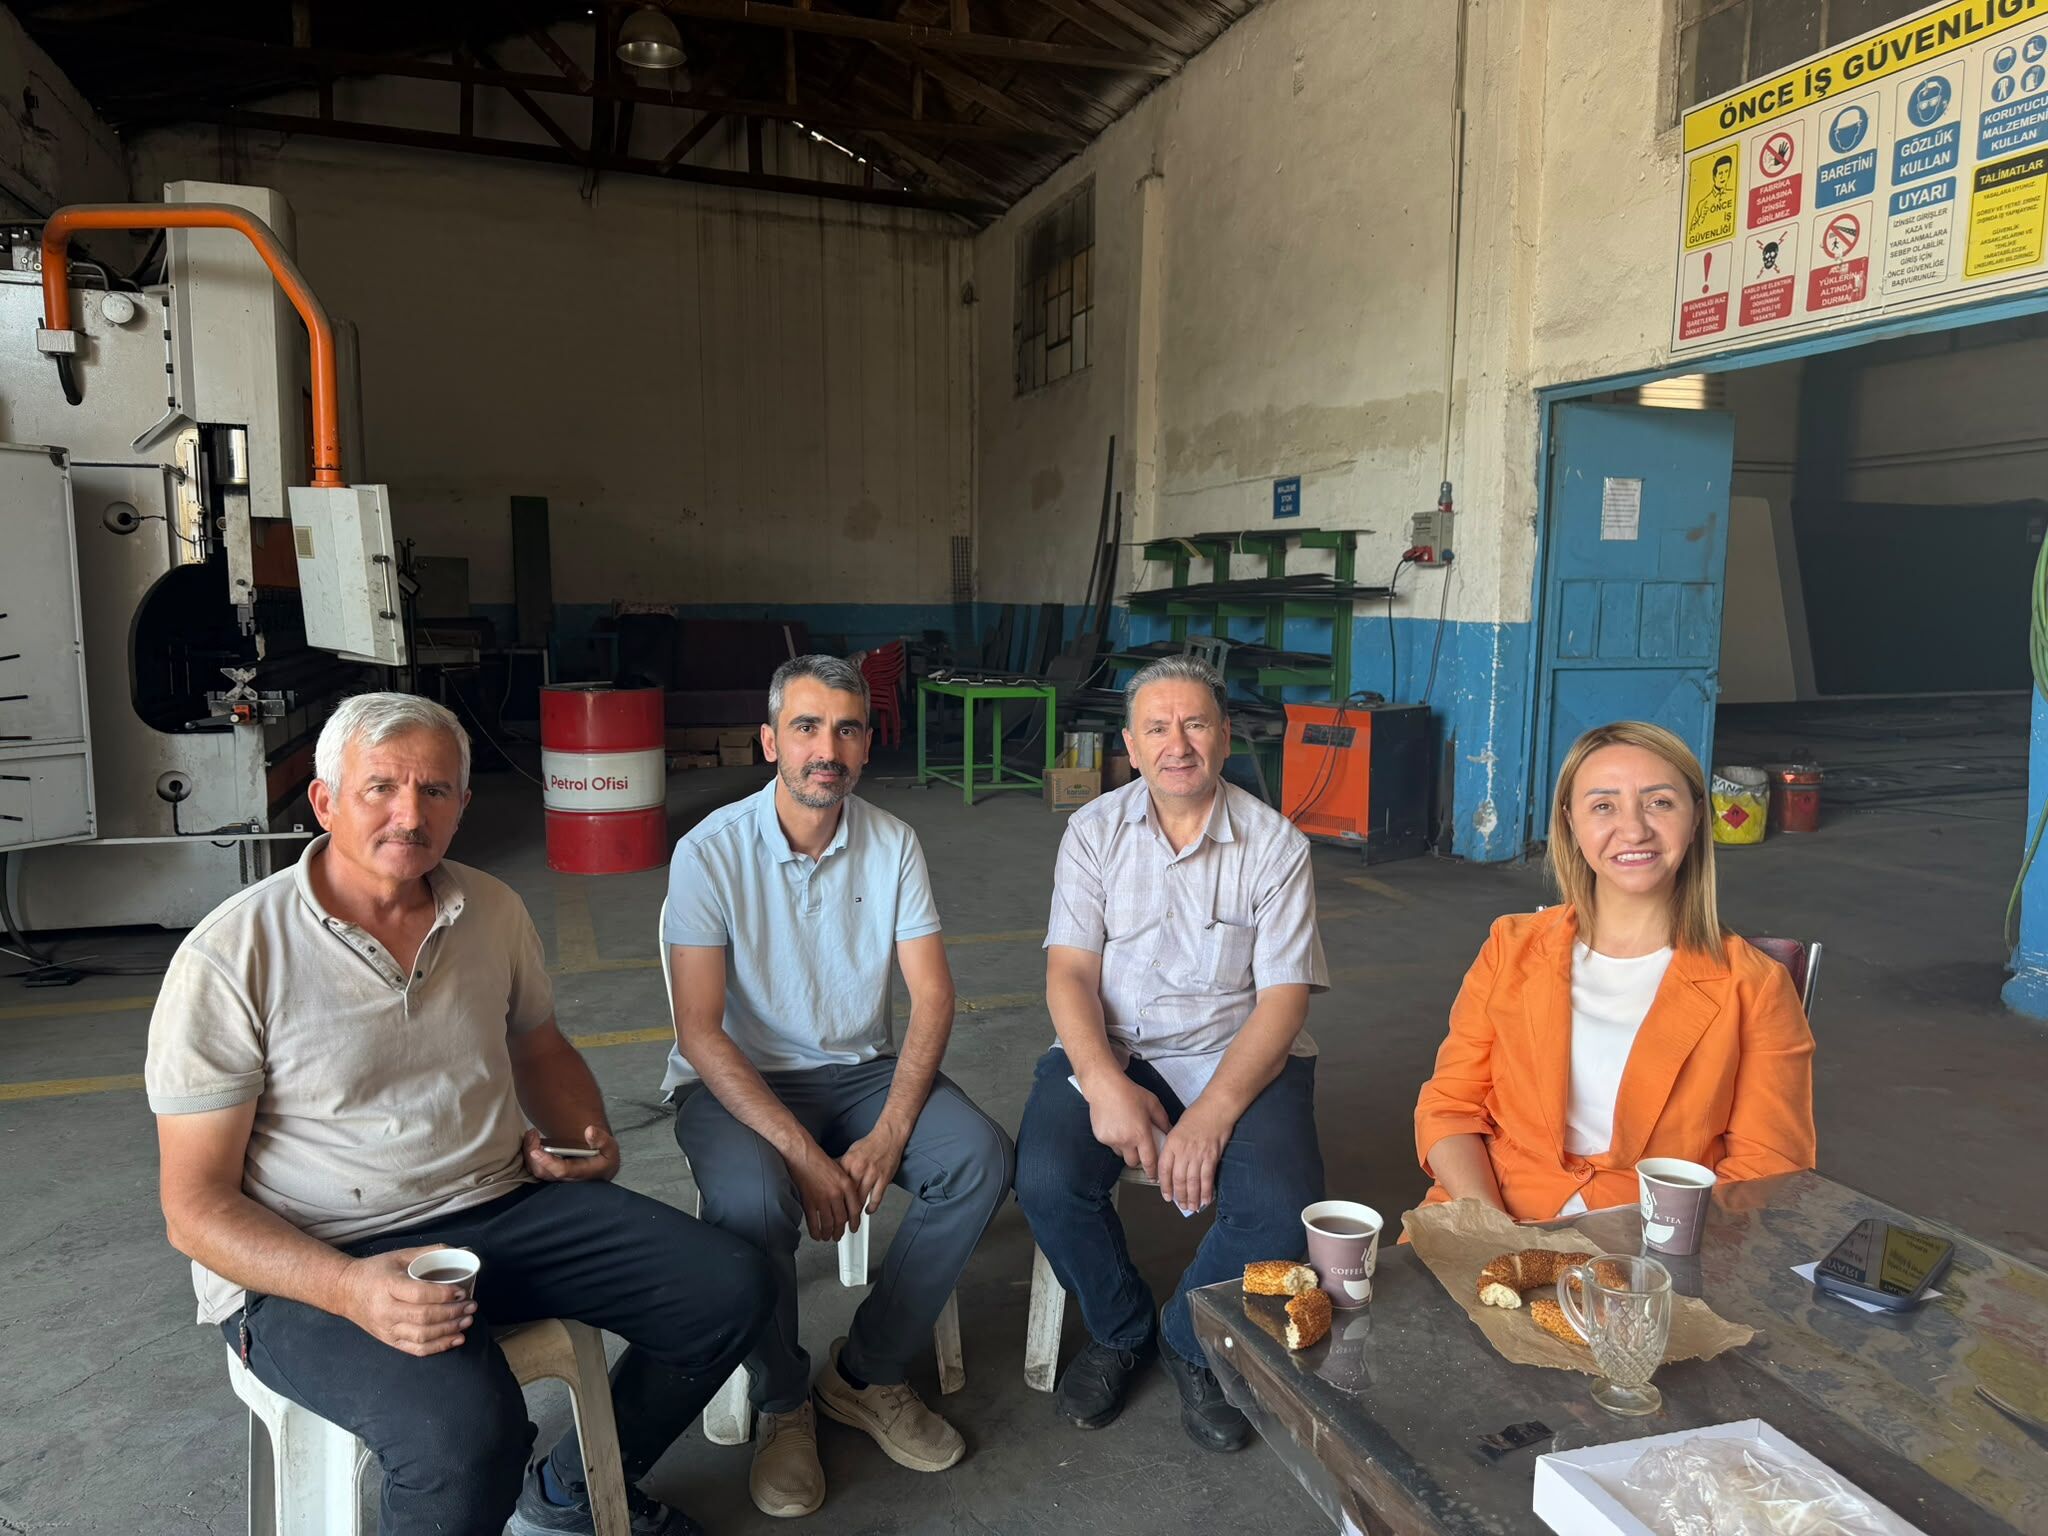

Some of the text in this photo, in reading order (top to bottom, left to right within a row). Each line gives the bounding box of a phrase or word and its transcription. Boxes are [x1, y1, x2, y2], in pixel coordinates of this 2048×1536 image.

[1719, 82, 1794, 129] ÖNCE
[1805, 67, 1832, 97] İŞ
[1901, 129, 1953, 157] GÖZLÜK
[1990, 129, 2037, 151] KULLAN
[1821, 153, 1873, 183] BARETİNİ
[1900, 150, 1950, 177] KULLAN
[1980, 159, 2043, 185] TALİMATLAR
[1834, 180, 1856, 197] TAK
[1899, 183, 1947, 209] UYARI
[1710, 199, 1732, 214] ÖNCE
[1724, 211, 1732, 222] İŞ
[1689, 222, 1731, 244] GÜVENLİĞİ
[1904, 224, 1922, 234] KAZA
[1889, 247, 1911, 258] SEBEP
[1820, 283, 1853, 296] ALTINDA
[551, 775, 628, 791] Petrol Ofisi
[1665, 1216, 1681, 1225] TEA
